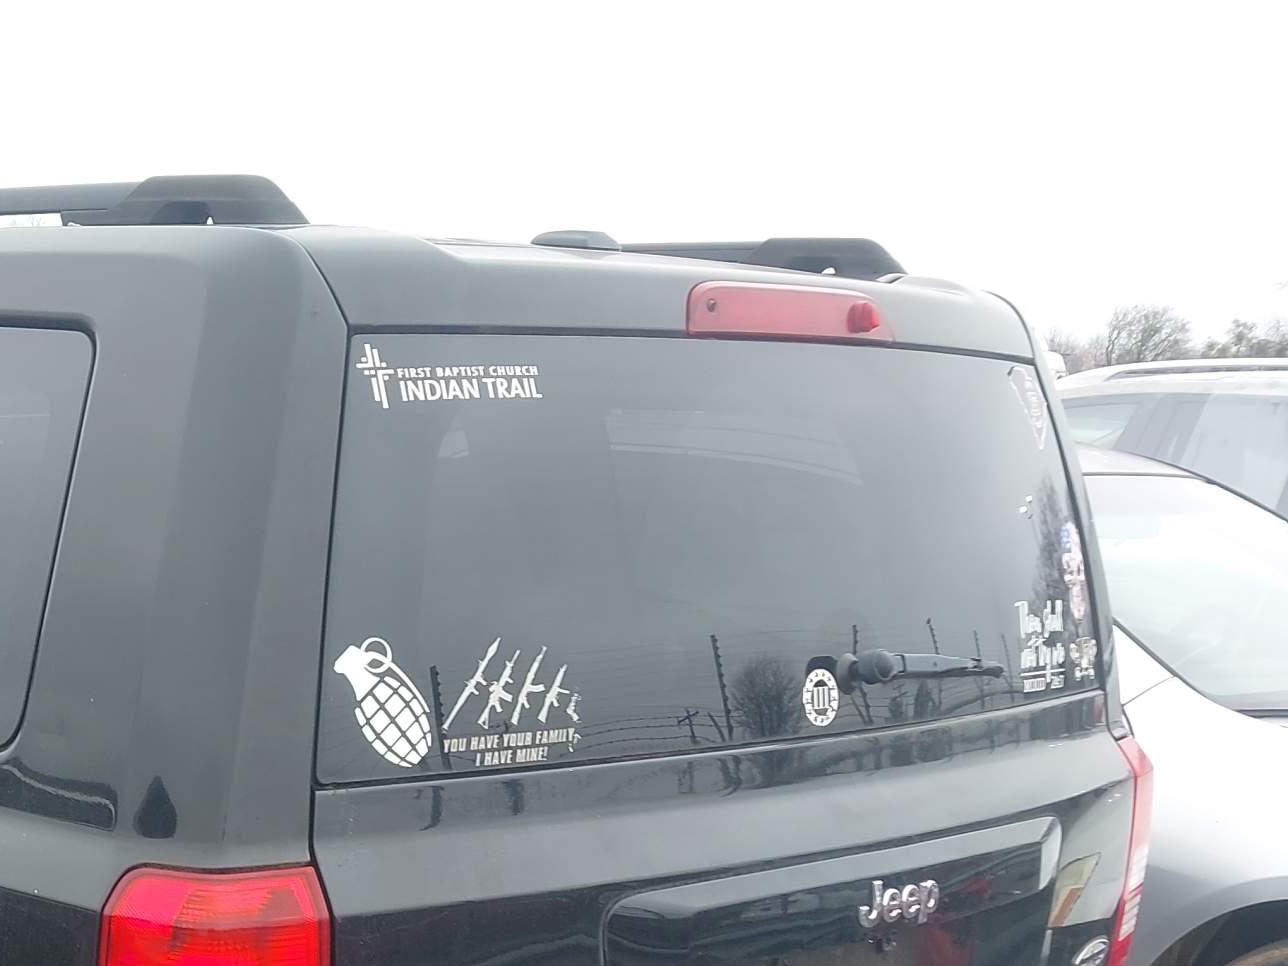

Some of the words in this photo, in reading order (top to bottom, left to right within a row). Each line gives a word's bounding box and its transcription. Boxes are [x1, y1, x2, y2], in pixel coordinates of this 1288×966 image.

[397, 367, 432, 379] FIRST
[436, 366, 485, 377] BAPTIST
[489, 365, 538, 376] CHURCH
[400, 378, 480, 401] INDIAN
[482, 378, 543, 400] TRAIL
[443, 738, 467, 753] YOU
[470, 735, 500, 751] HAVE
[502, 732, 533, 747] YOUR
[484, 750, 513, 766] HAVE
[515, 746, 548, 763] MINE!
[858, 879, 941, 928] Jeep
